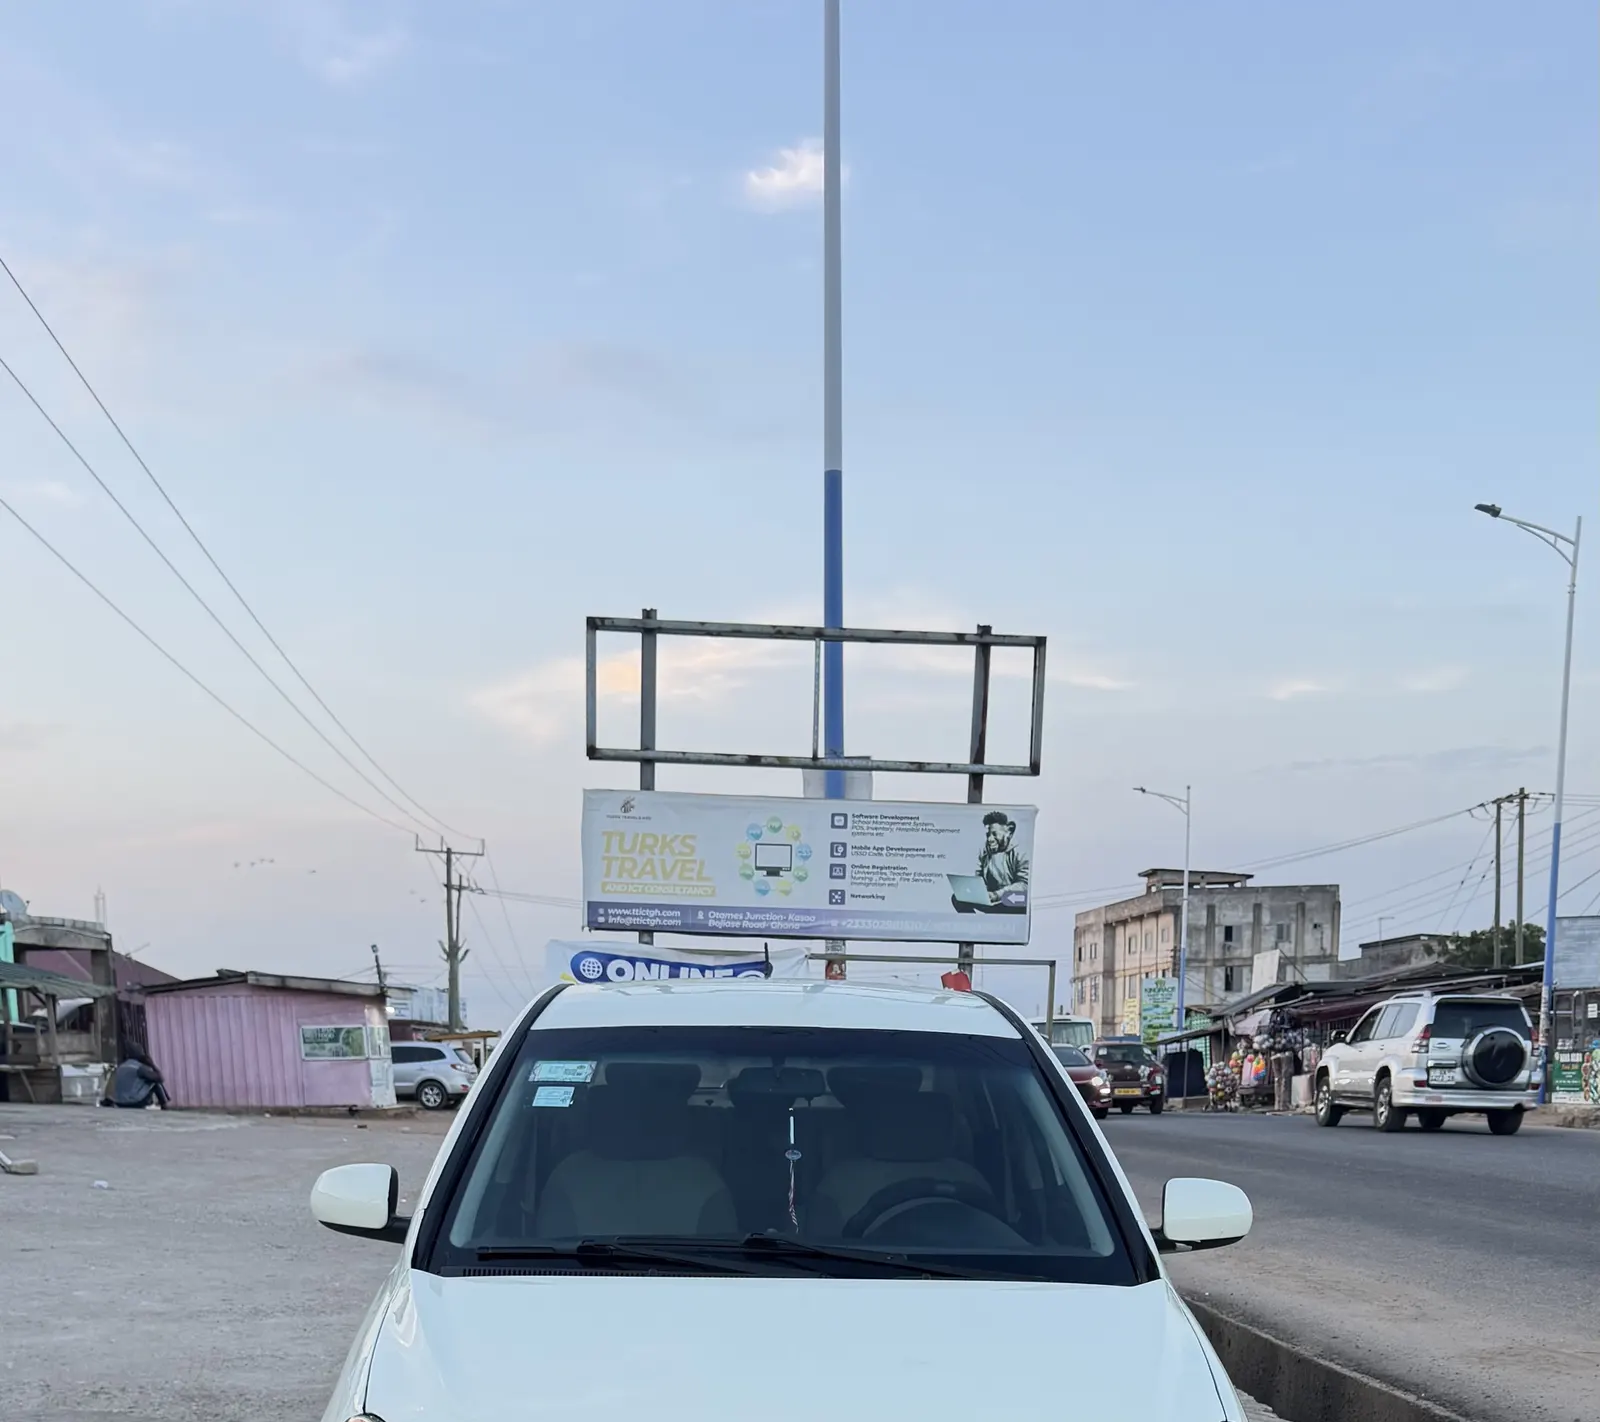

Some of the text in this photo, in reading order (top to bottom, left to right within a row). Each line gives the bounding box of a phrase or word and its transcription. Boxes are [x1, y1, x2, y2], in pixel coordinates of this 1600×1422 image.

[921, 827, 961, 835] Management
[602, 831, 697, 857] TURKS
[602, 856, 714, 882] TRAVEL
[606, 883, 714, 896] AND ICT CONSULTANCY
[850, 893, 886, 901] Networking
[608, 907, 681, 918] www.ttictgh.com
[787, 913, 816, 922] Kasoa
[608, 915, 682, 927] info@ttictgh.com
[770, 921, 800, 930] Ghana
